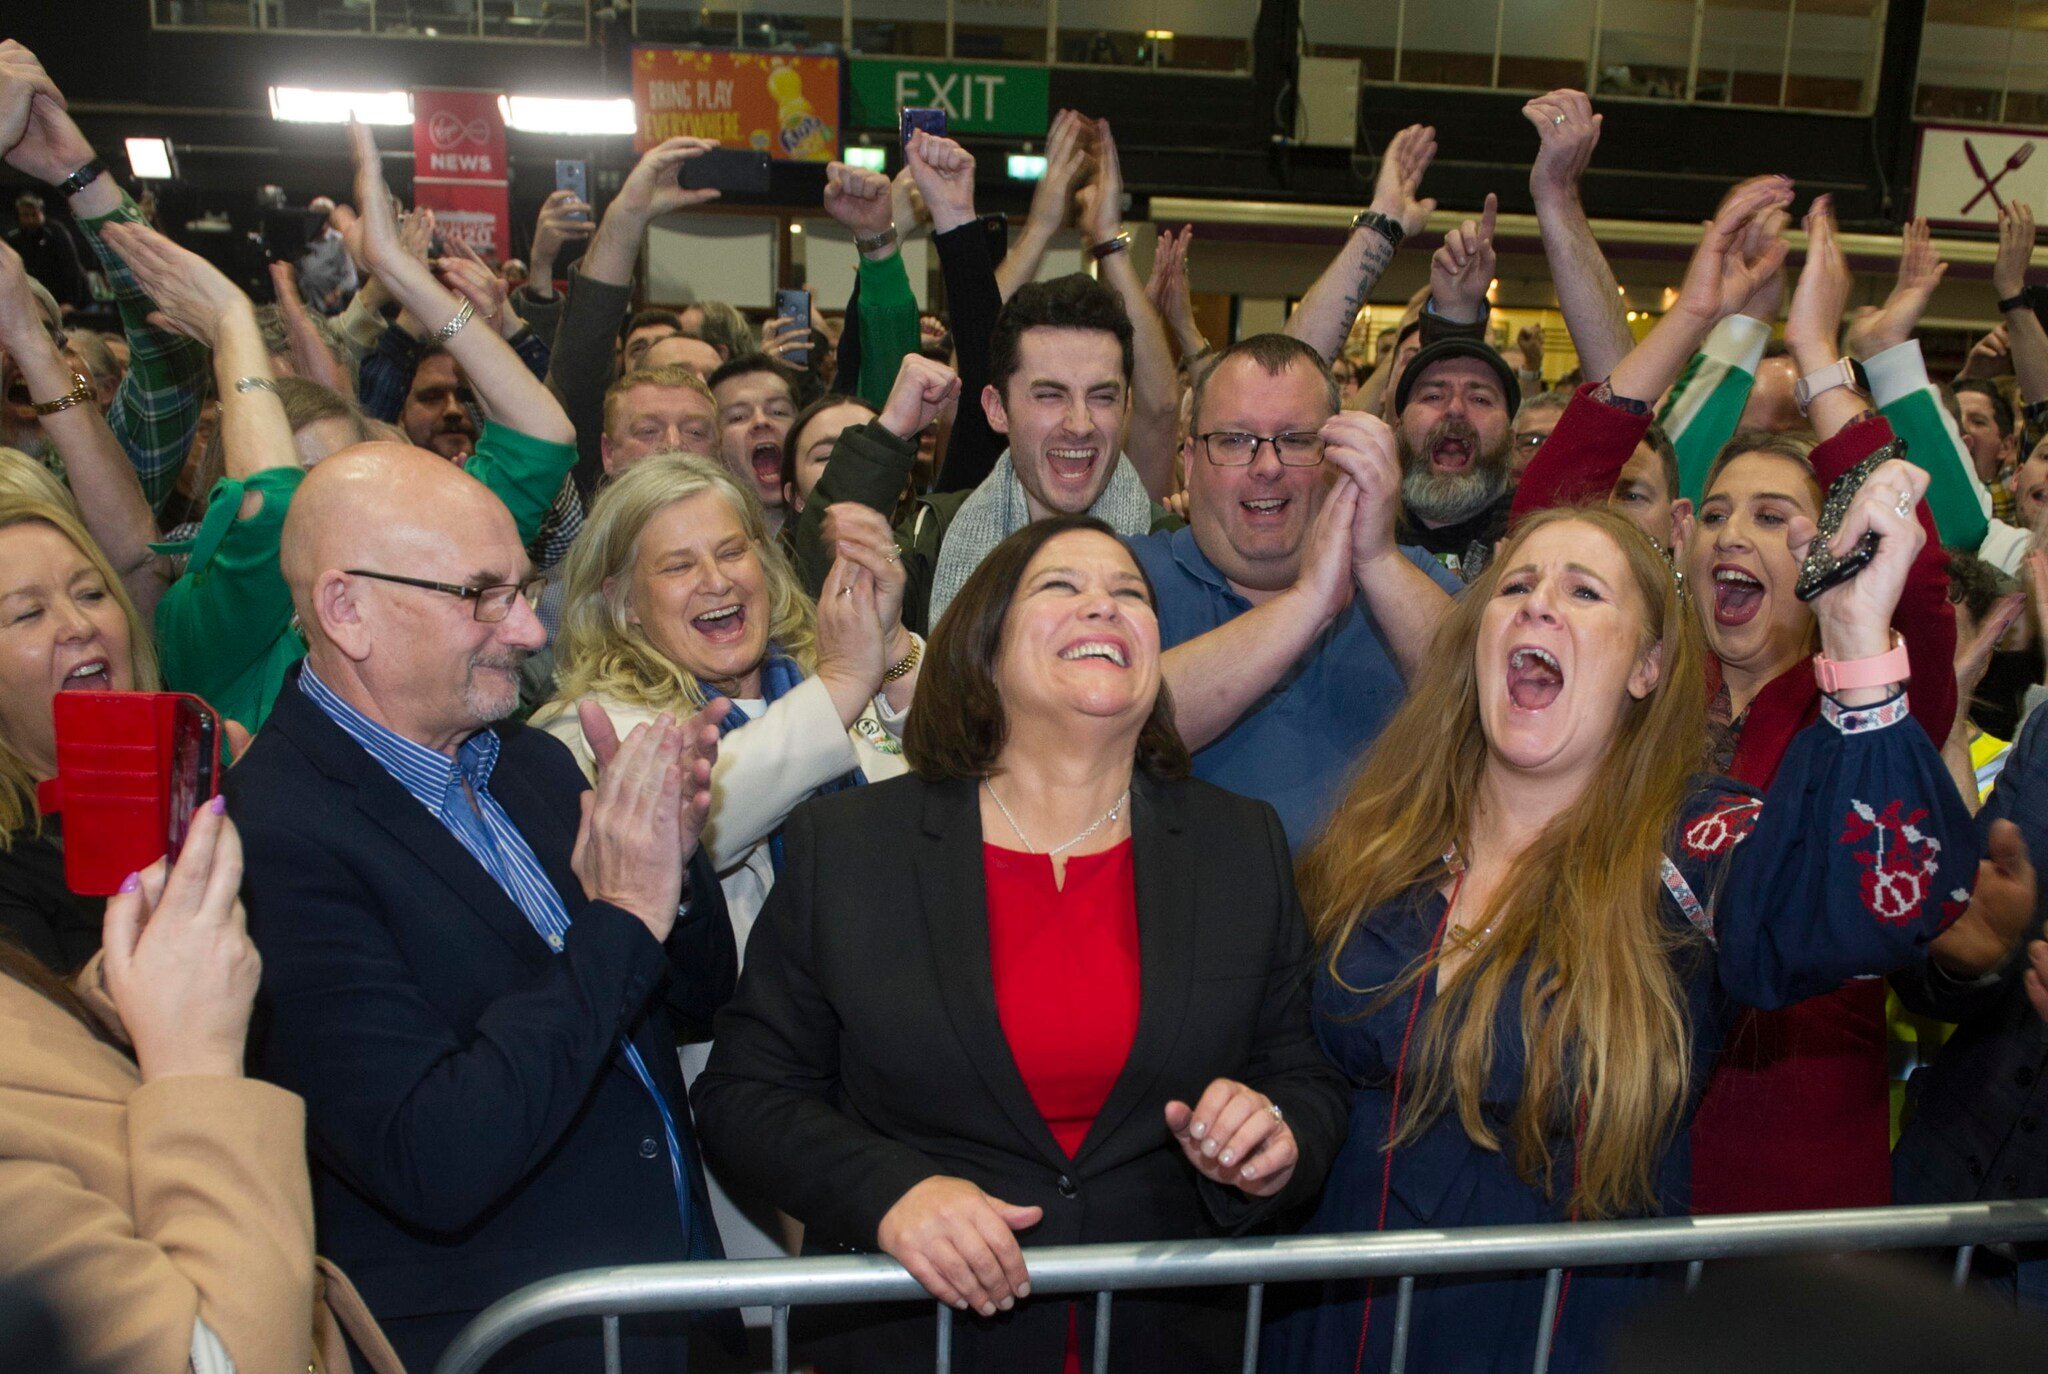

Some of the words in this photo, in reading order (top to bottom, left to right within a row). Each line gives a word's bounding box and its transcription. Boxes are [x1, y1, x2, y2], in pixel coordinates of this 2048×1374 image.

[649, 79, 692, 110] BRING
[697, 79, 735, 110] PLAY
[896, 70, 1005, 121] EXIT
[430, 152, 492, 173] NEWS
